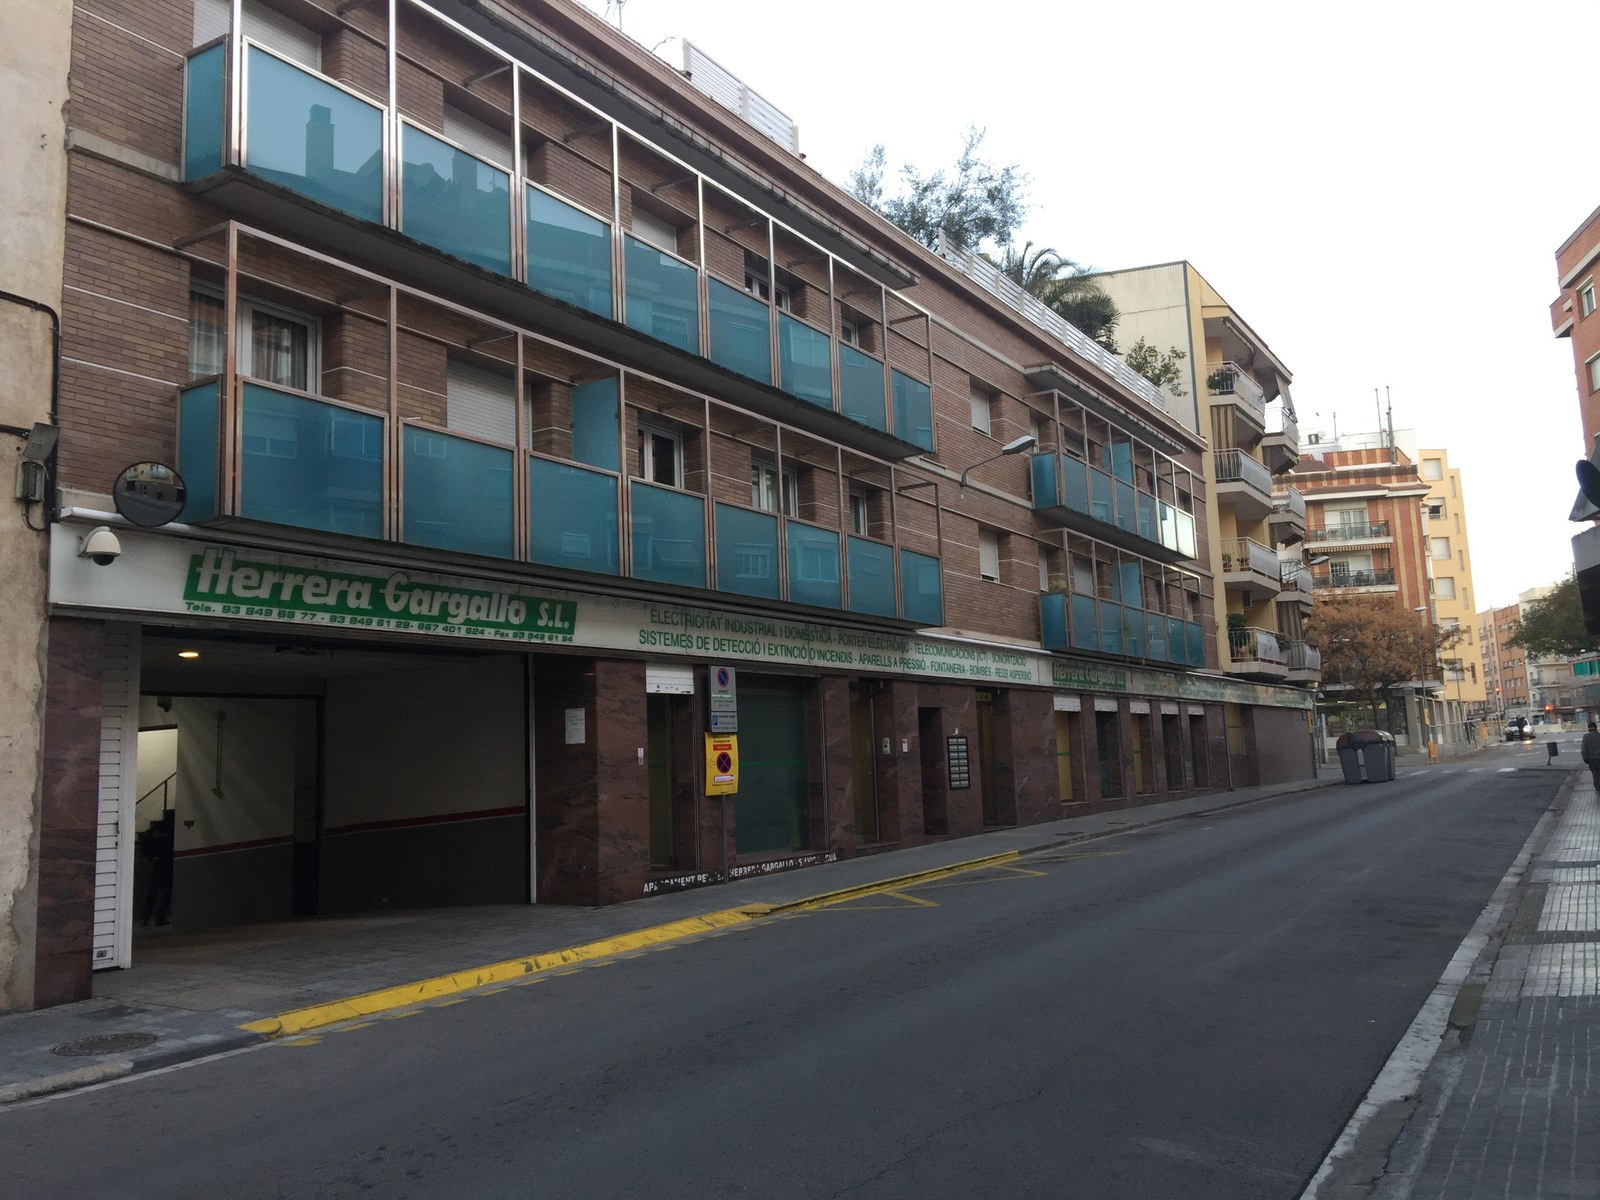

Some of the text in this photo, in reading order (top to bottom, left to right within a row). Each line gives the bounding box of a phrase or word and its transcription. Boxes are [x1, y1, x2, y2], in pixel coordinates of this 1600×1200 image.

[195, 546, 570, 629] Herrera Gargallo S.L.
[185, 601, 216, 613] Tels.
[221, 604, 241, 615] 93
[245, 606, 273, 617] 849
[300, 611, 318, 621] 77
[329, 614, 346, 624] 93
[350, 616, 373, 626] 849
[442, 624, 462, 634] 401
[494, 630, 510, 638] Fax
[650, 608, 723, 631] ELECTRICITAT
[724, 618, 777, 637] INDUSTRIAL
[837, 633, 867, 649] PORTER
[914, 642, 976, 661] TELECOMUNICACIONS
[639, 629, 694, 649] SISTEMES
[696, 636, 711, 651] DE
[713, 637, 761, 655] DETECCIÓ
[768, 643, 807, 661] EXTINCIÓ
[809, 647, 853, 664] D'INCENDIS
[858, 653, 892, 668] APARELLS
[893, 656, 899, 668] A
[899, 656, 926, 671] PRESSIÓ
[930, 661, 967, 675] FONTANERIA
[969, 665, 992, 678] BOMBES
